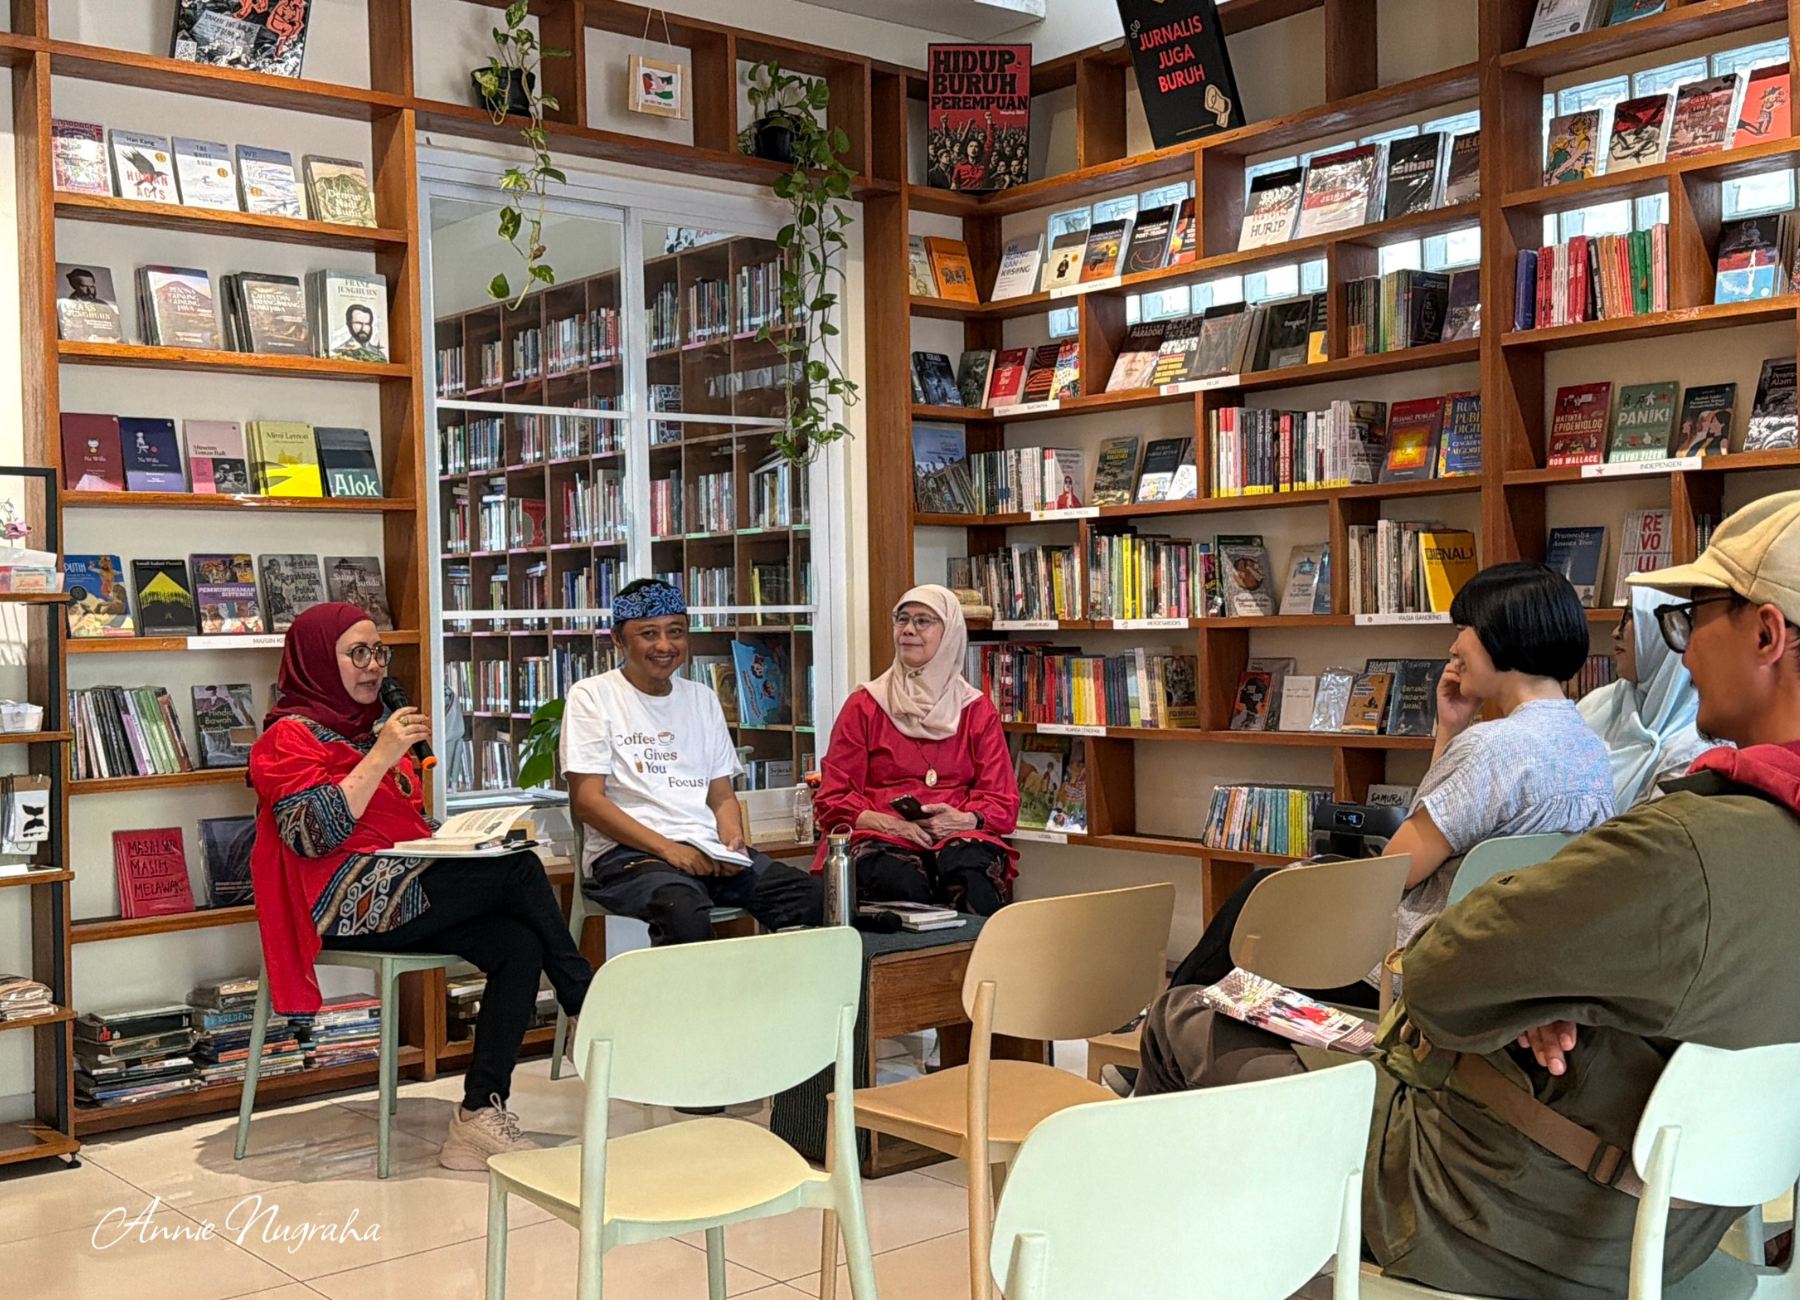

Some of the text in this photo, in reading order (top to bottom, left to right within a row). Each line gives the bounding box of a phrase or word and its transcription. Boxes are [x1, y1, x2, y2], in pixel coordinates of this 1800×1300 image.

[1140, 15, 1203, 51] JURNALIS
[933, 50, 1015, 73] HIDUP
[1159, 43, 1195, 69] JUGA
[933, 73, 1017, 94] BURUH
[1158, 64, 1205, 93] BURUH
[931, 96, 1028, 110] PEREMPUAN
[126, 170, 169, 187] HUMAN
[136, 186, 166, 200] ACTS
[1251, 219, 1286, 238] HURIP
[284, 432, 309, 441] Lemon
[1549, 455, 1598, 466] ROB WALLACE
[334, 473, 379, 497] Alok
[1643, 514, 1663, 532] RE
[1641, 533, 1662, 551] VO
[1637, 555, 1657, 572] LU
[616, 732, 656, 747] Coffee
[643, 748, 678, 762] Gives
[645, 761, 667, 774] You
[668, 776, 704, 788] Focus
[130, 859, 169, 877] MASIH
